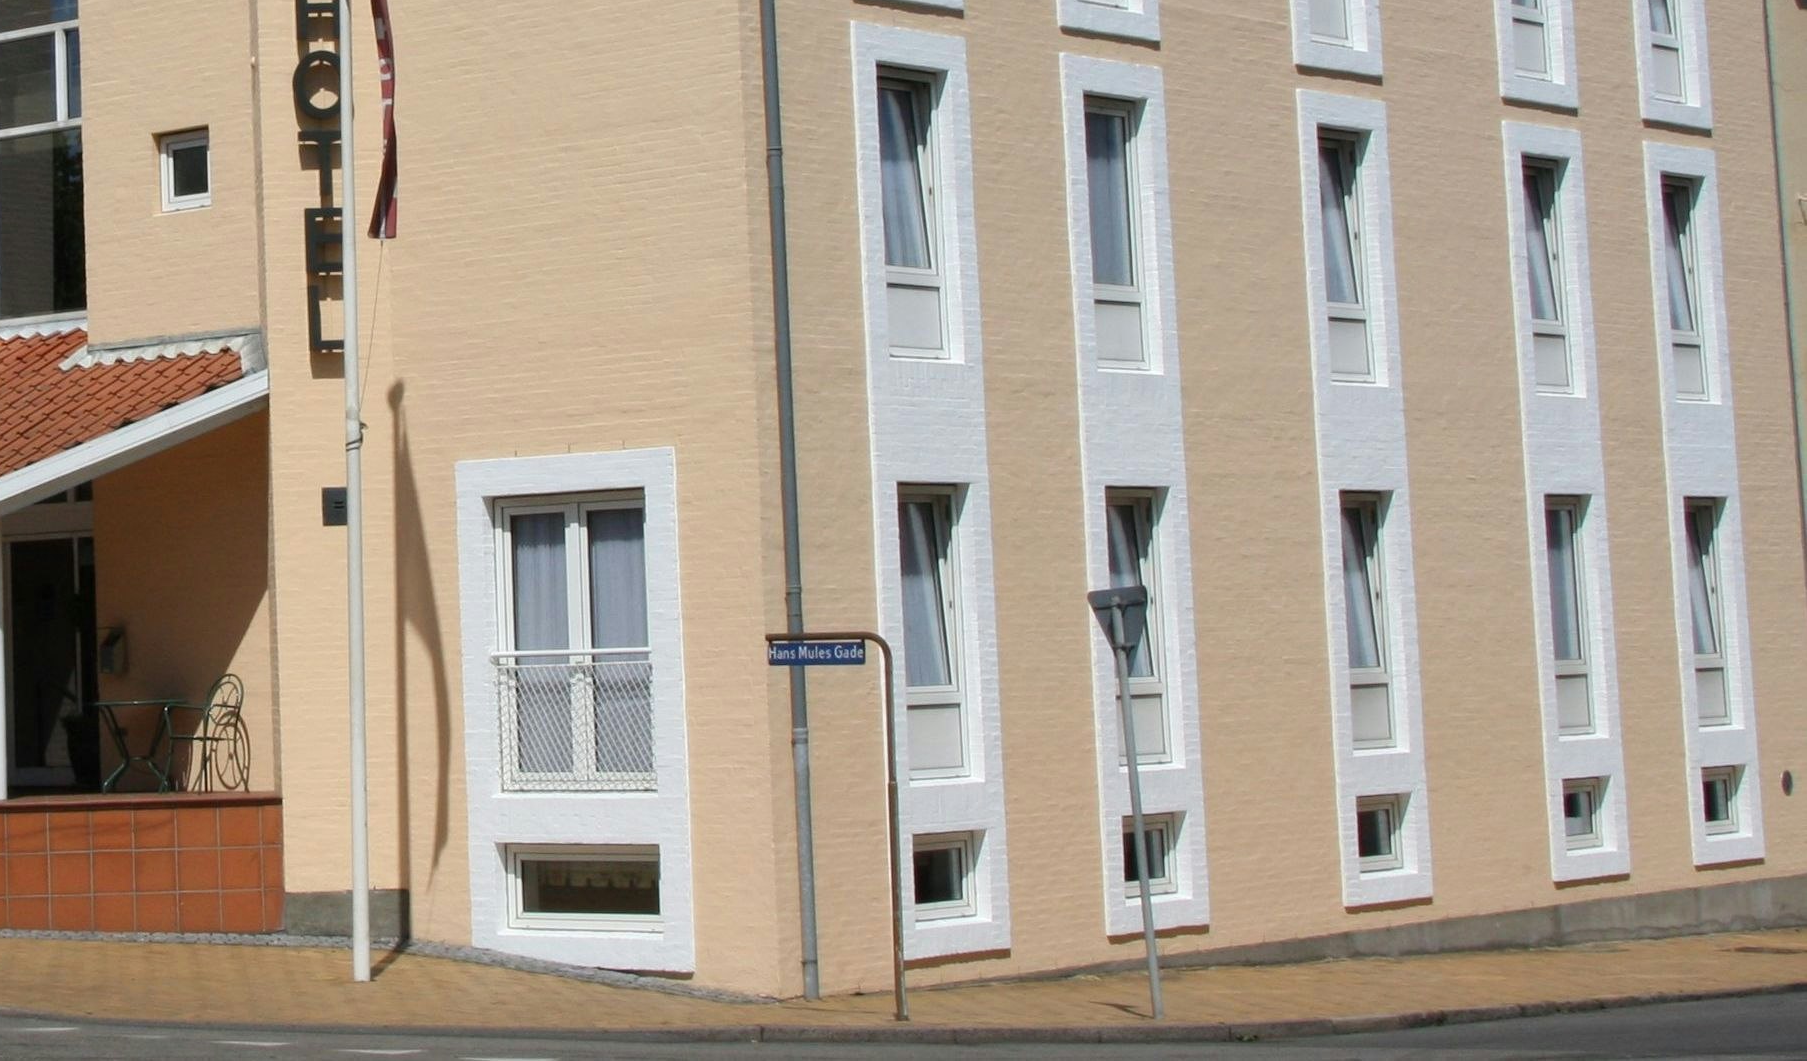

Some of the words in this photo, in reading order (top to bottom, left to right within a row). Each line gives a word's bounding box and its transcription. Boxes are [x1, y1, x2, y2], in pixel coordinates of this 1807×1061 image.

[769, 646, 796, 659] Hans
[798, 646, 832, 659] Mules
[834, 645, 864, 658] Gade
